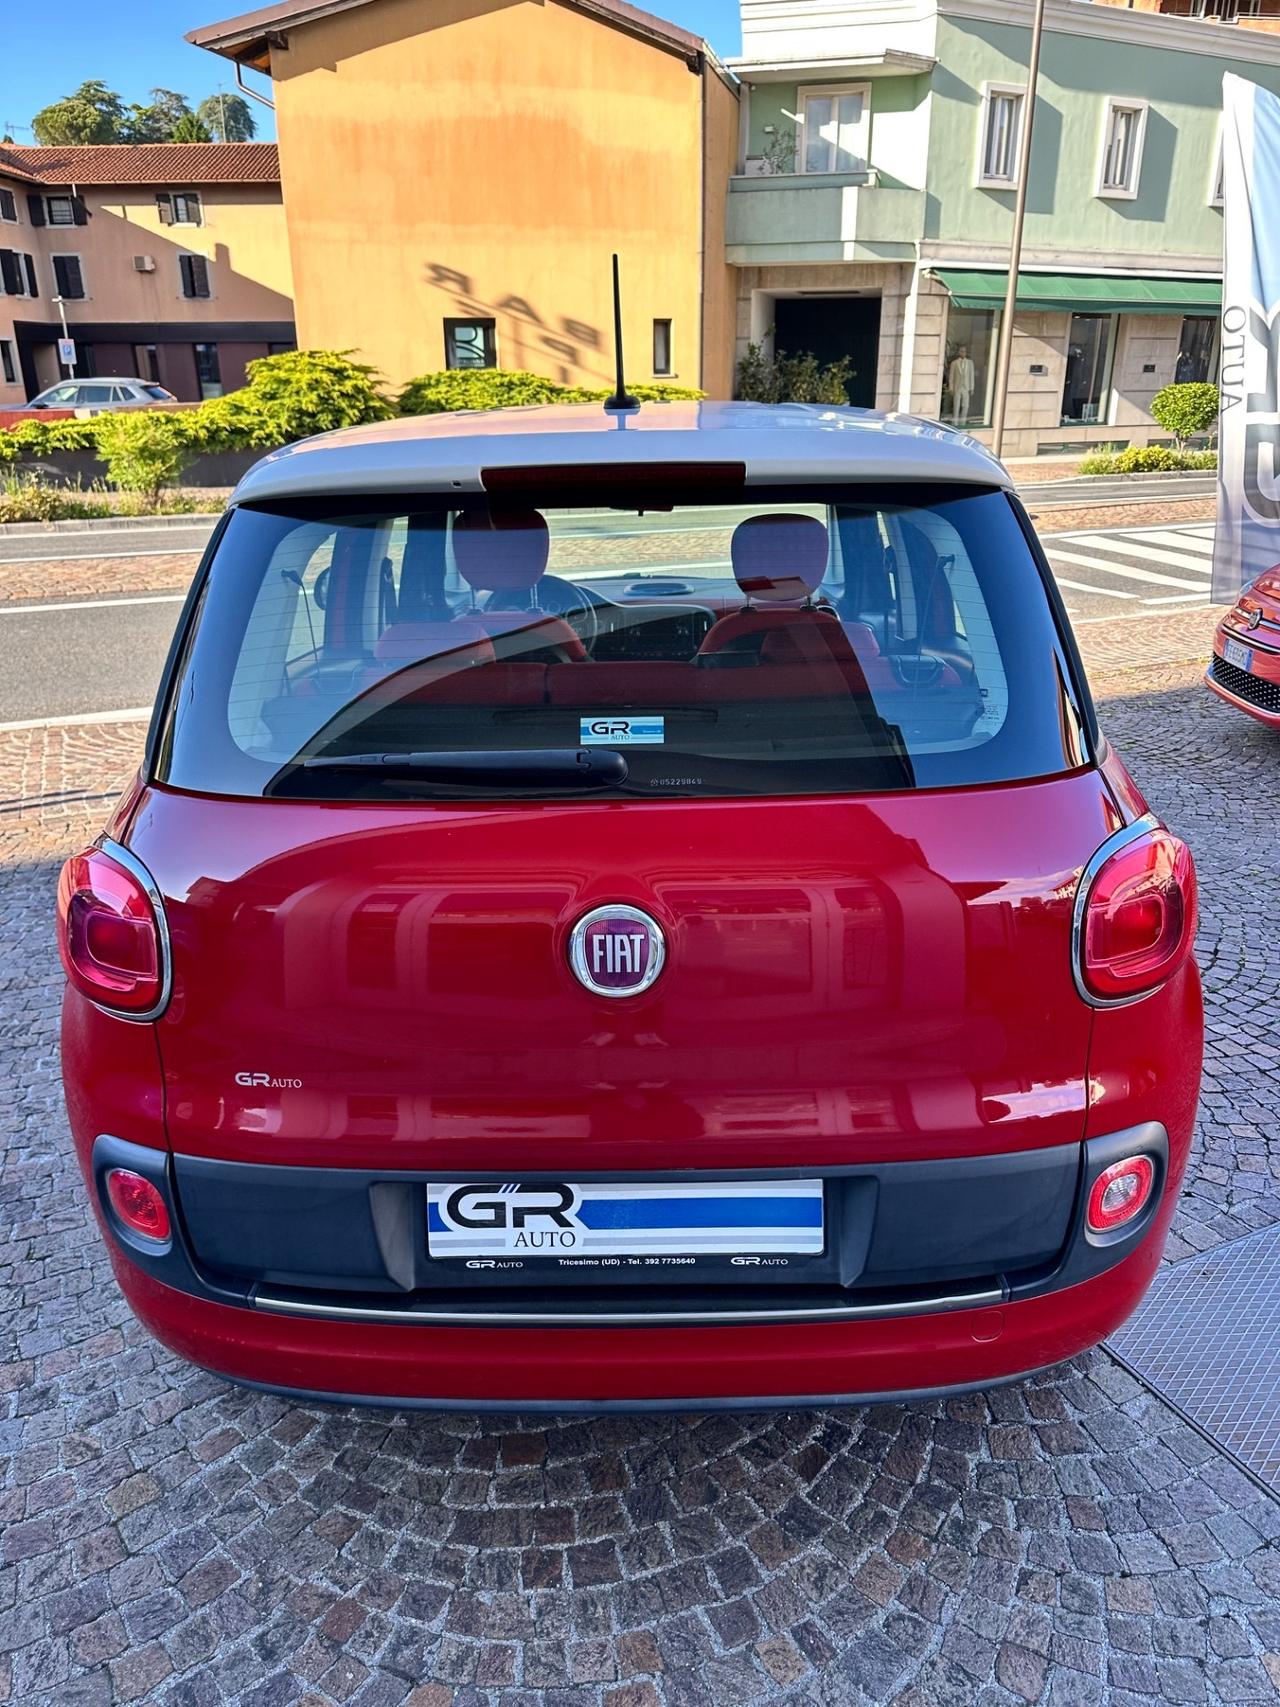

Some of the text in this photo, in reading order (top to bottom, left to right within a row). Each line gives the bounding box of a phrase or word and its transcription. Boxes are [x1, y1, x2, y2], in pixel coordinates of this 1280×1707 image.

[591, 721, 630, 735] GR
[592, 934, 645, 973] FIAT
[234, 1071, 303, 1089] GR AUTO
[446, 1183, 576, 1229] GR
[513, 1231, 577, 1248] AUTO
[465, 1260, 524, 1269] GR AUTO
[558, 1258, 600, 1266] Tricesimo
[601, 1258, 620, 1266] (UD)
[645, 1257, 660, 1265] 392
[661, 1257, 696, 1265] 7735640
[730, 1256, 789, 1266] GR AUTO
